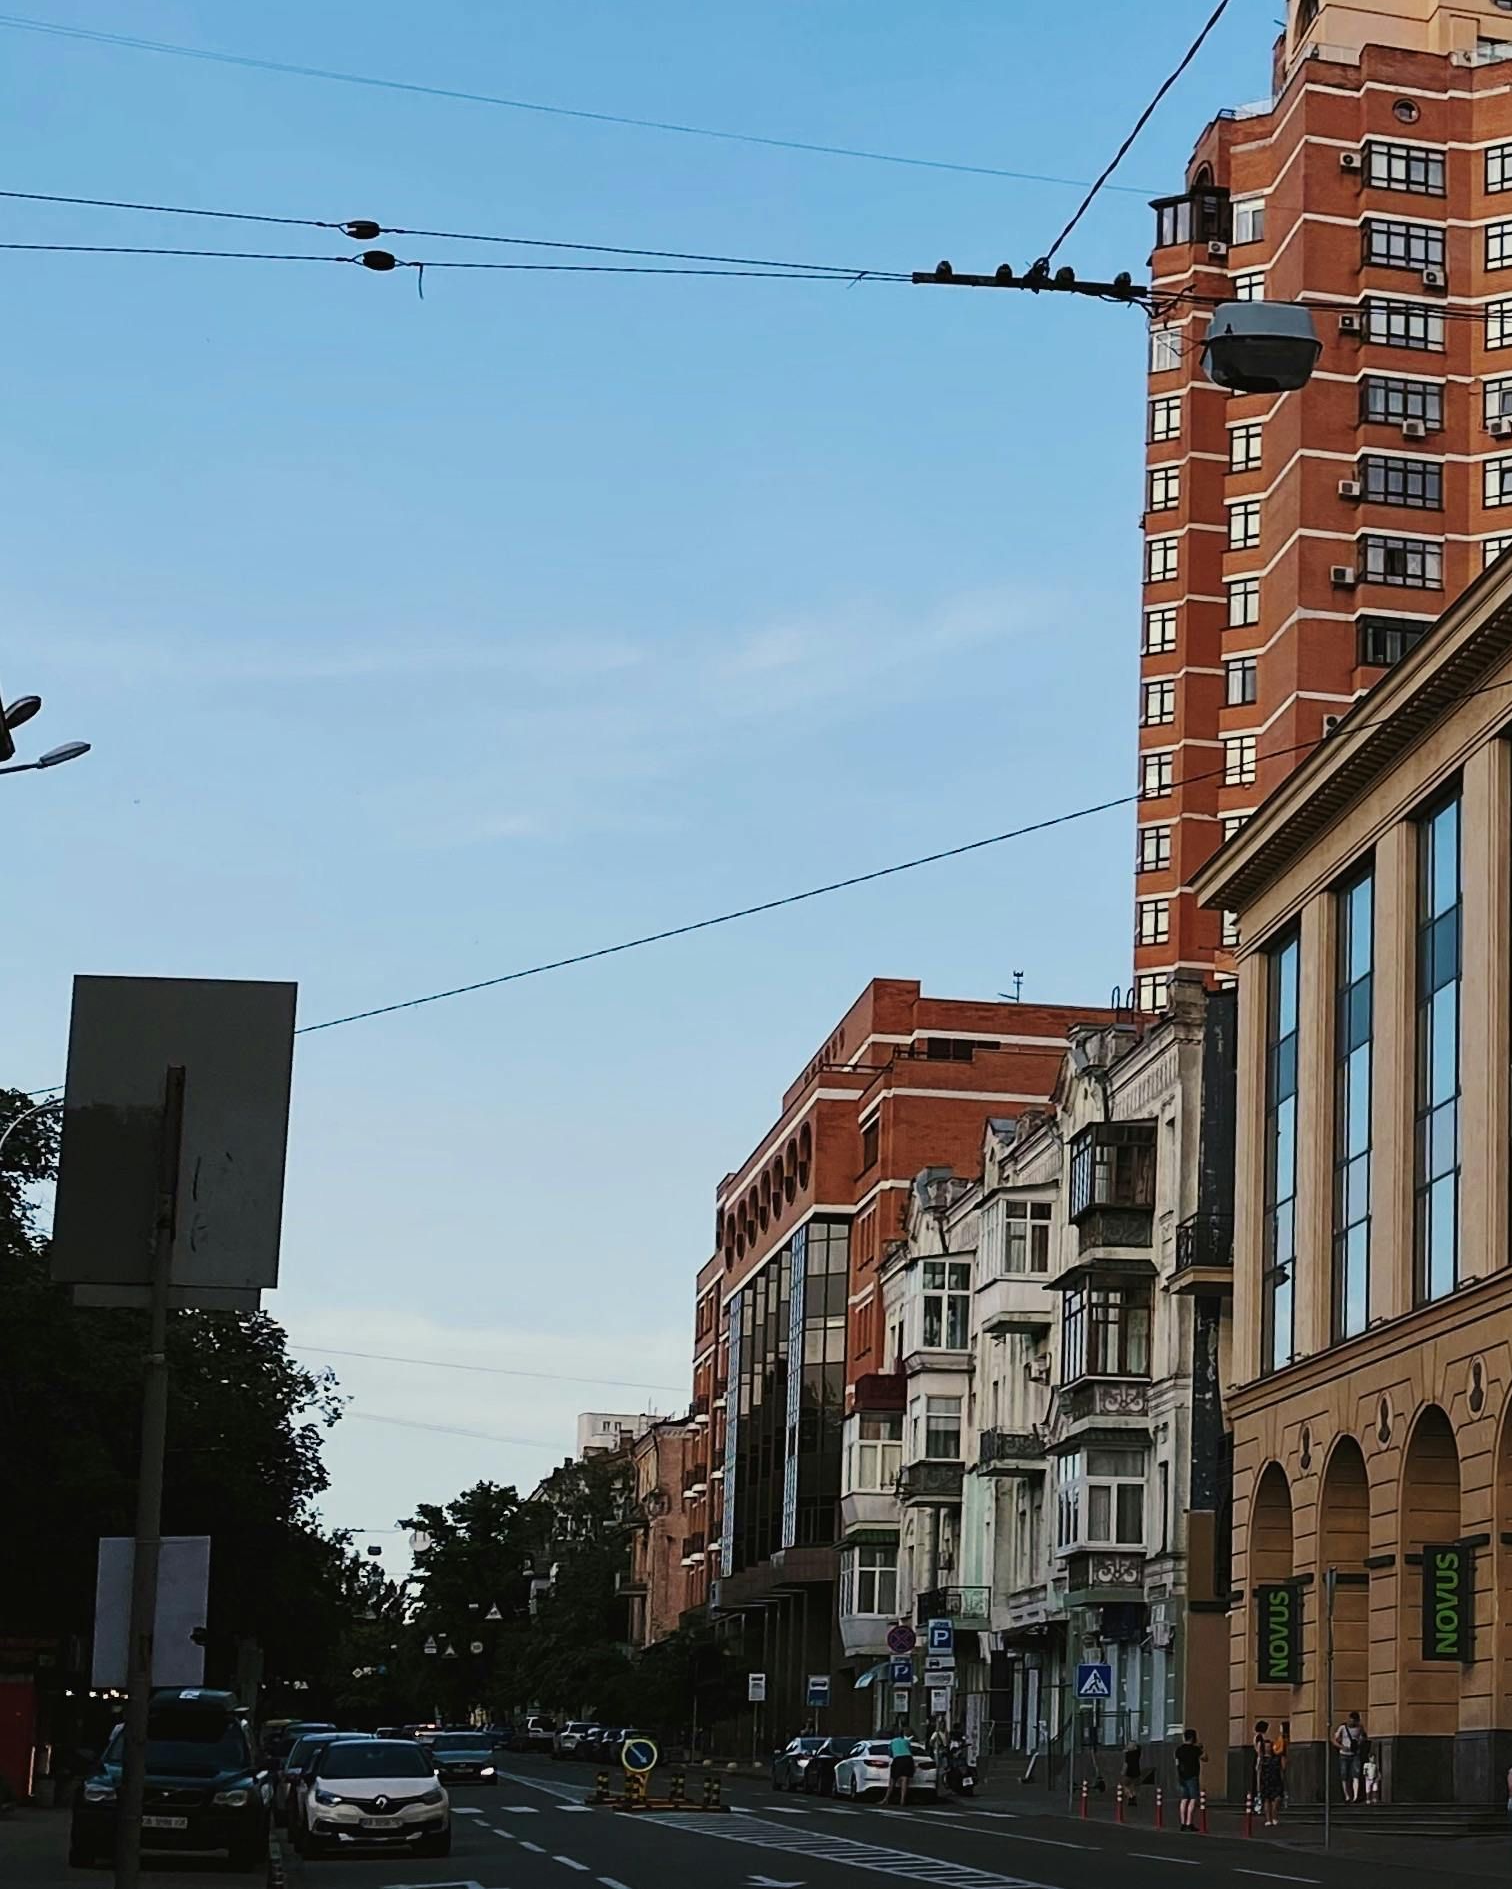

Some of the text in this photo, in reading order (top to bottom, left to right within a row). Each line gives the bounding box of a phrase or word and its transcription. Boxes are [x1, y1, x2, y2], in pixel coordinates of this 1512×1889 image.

[1434, 1551, 1460, 1655] NOVUS
[933, 1629, 949, 1647] P
[1268, 1590, 1290, 1678] NOVUS
[894, 1664, 909, 1680] P
